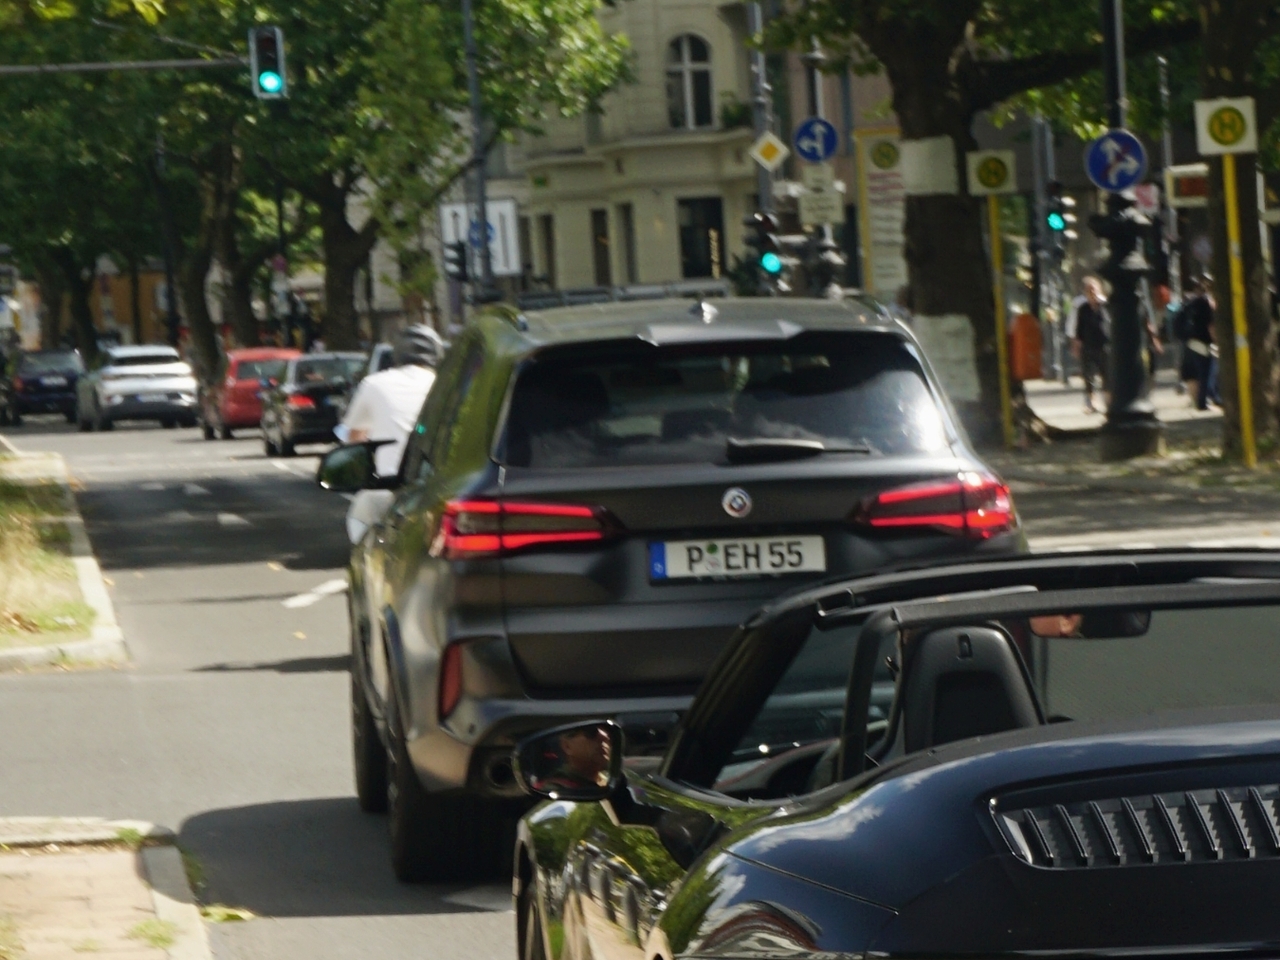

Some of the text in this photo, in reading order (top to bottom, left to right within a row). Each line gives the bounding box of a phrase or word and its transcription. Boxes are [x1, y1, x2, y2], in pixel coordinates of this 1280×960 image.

[685, 541, 804, 572] P EH 55
